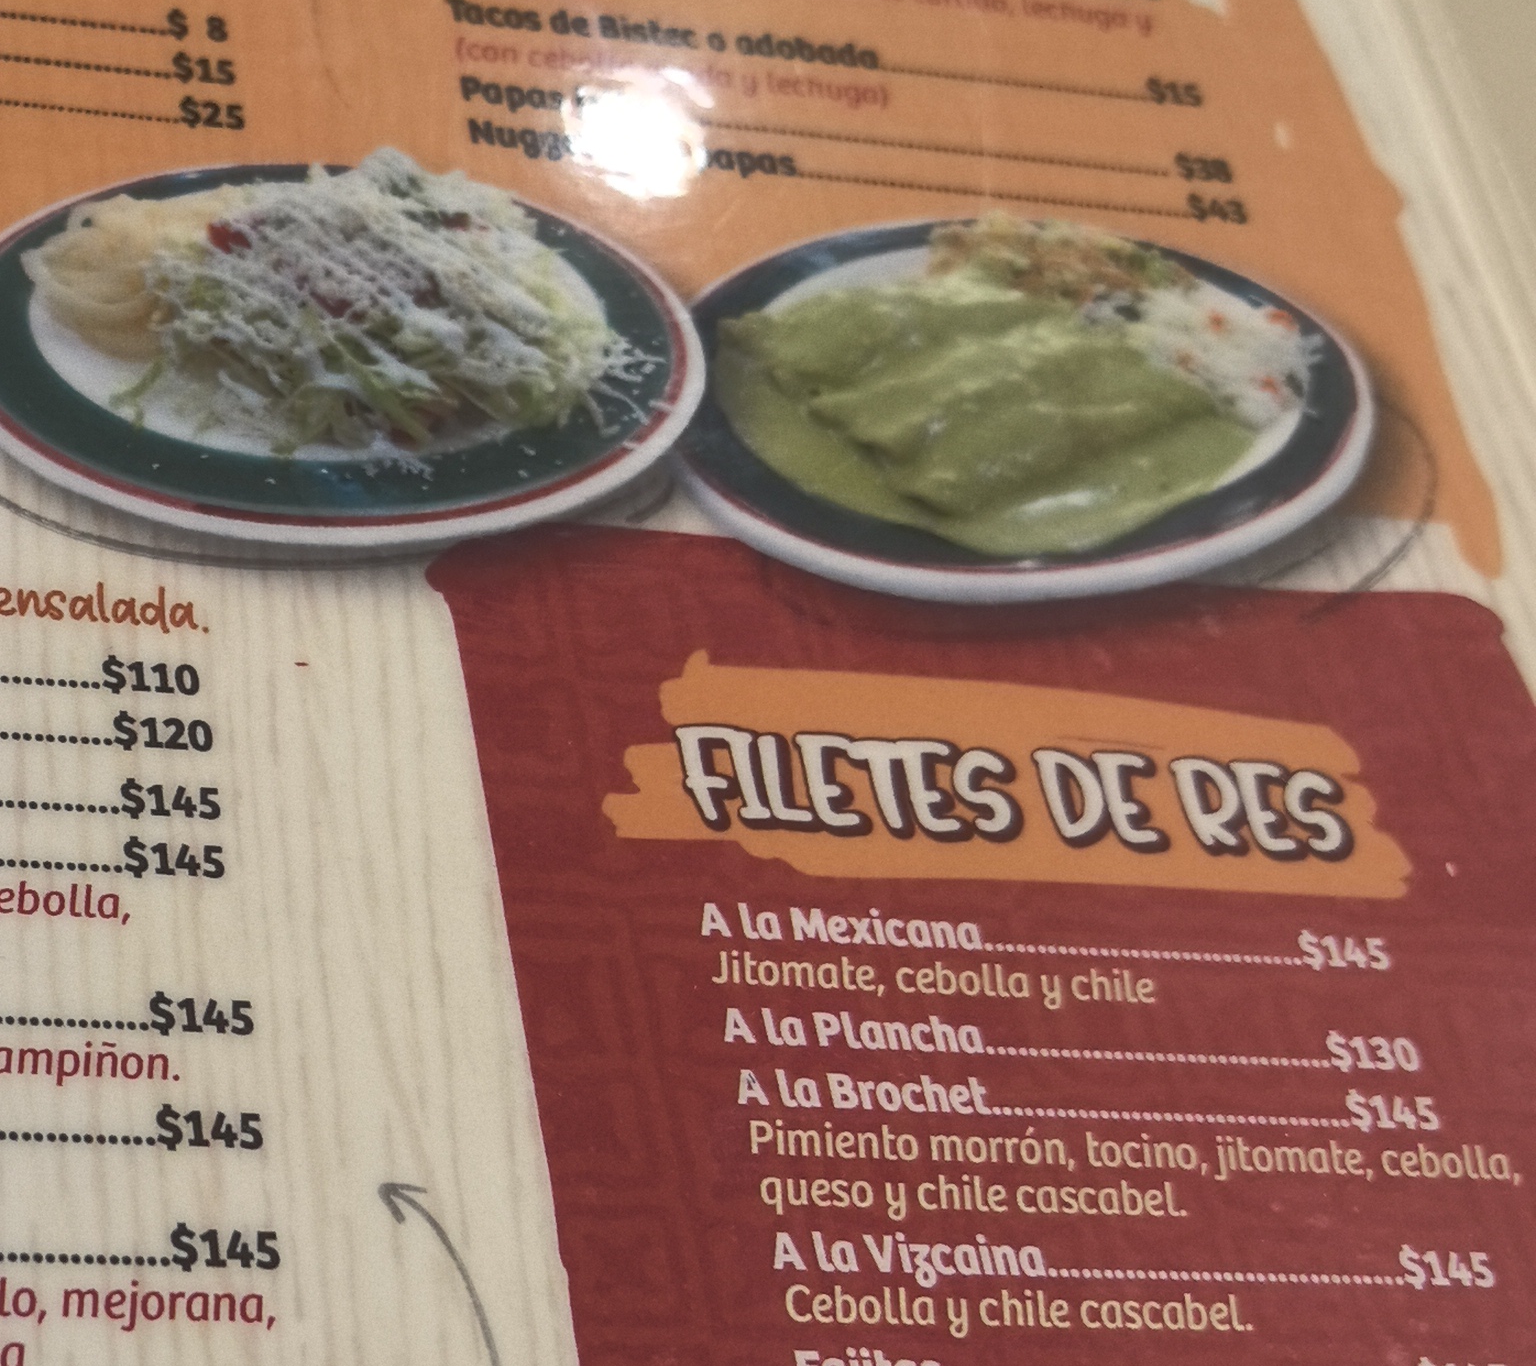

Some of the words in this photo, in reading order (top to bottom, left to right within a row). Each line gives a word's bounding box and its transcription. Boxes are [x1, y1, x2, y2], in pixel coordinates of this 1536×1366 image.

[172, 51, 237, 86] $15
[179, 95, 245, 132] $25
[103, 658, 202, 698] $110
[114, 712, 214, 753] $120
[121, 780, 223, 821] $145
[675, 723, 1023, 843] FILETES
[1031, 748, 1171, 853] DE
[1170, 757, 1354, 861] RES
[700, 902, 733, 938] A
[738, 904, 784, 941] la
[792, 906, 983, 954] Mexicana
[1299, 932, 1392, 972] $145
[711, 949, 886, 998] Jitomate,
[895, 961, 1035, 1002] cebolla
[1040, 970, 1066, 1011] y
[1071, 966, 1158, 1004] chile
[151, 993, 256, 1037] $145
[723, 1007, 758, 1045] A
[763, 1007, 807, 1048] la
[814, 1011, 985, 1058] Plancha
[1327, 1032, 1422, 1072] $130
[1400, 1246, 1497, 1290] $145
[61, 1279, 276, 1333] mejorana,
